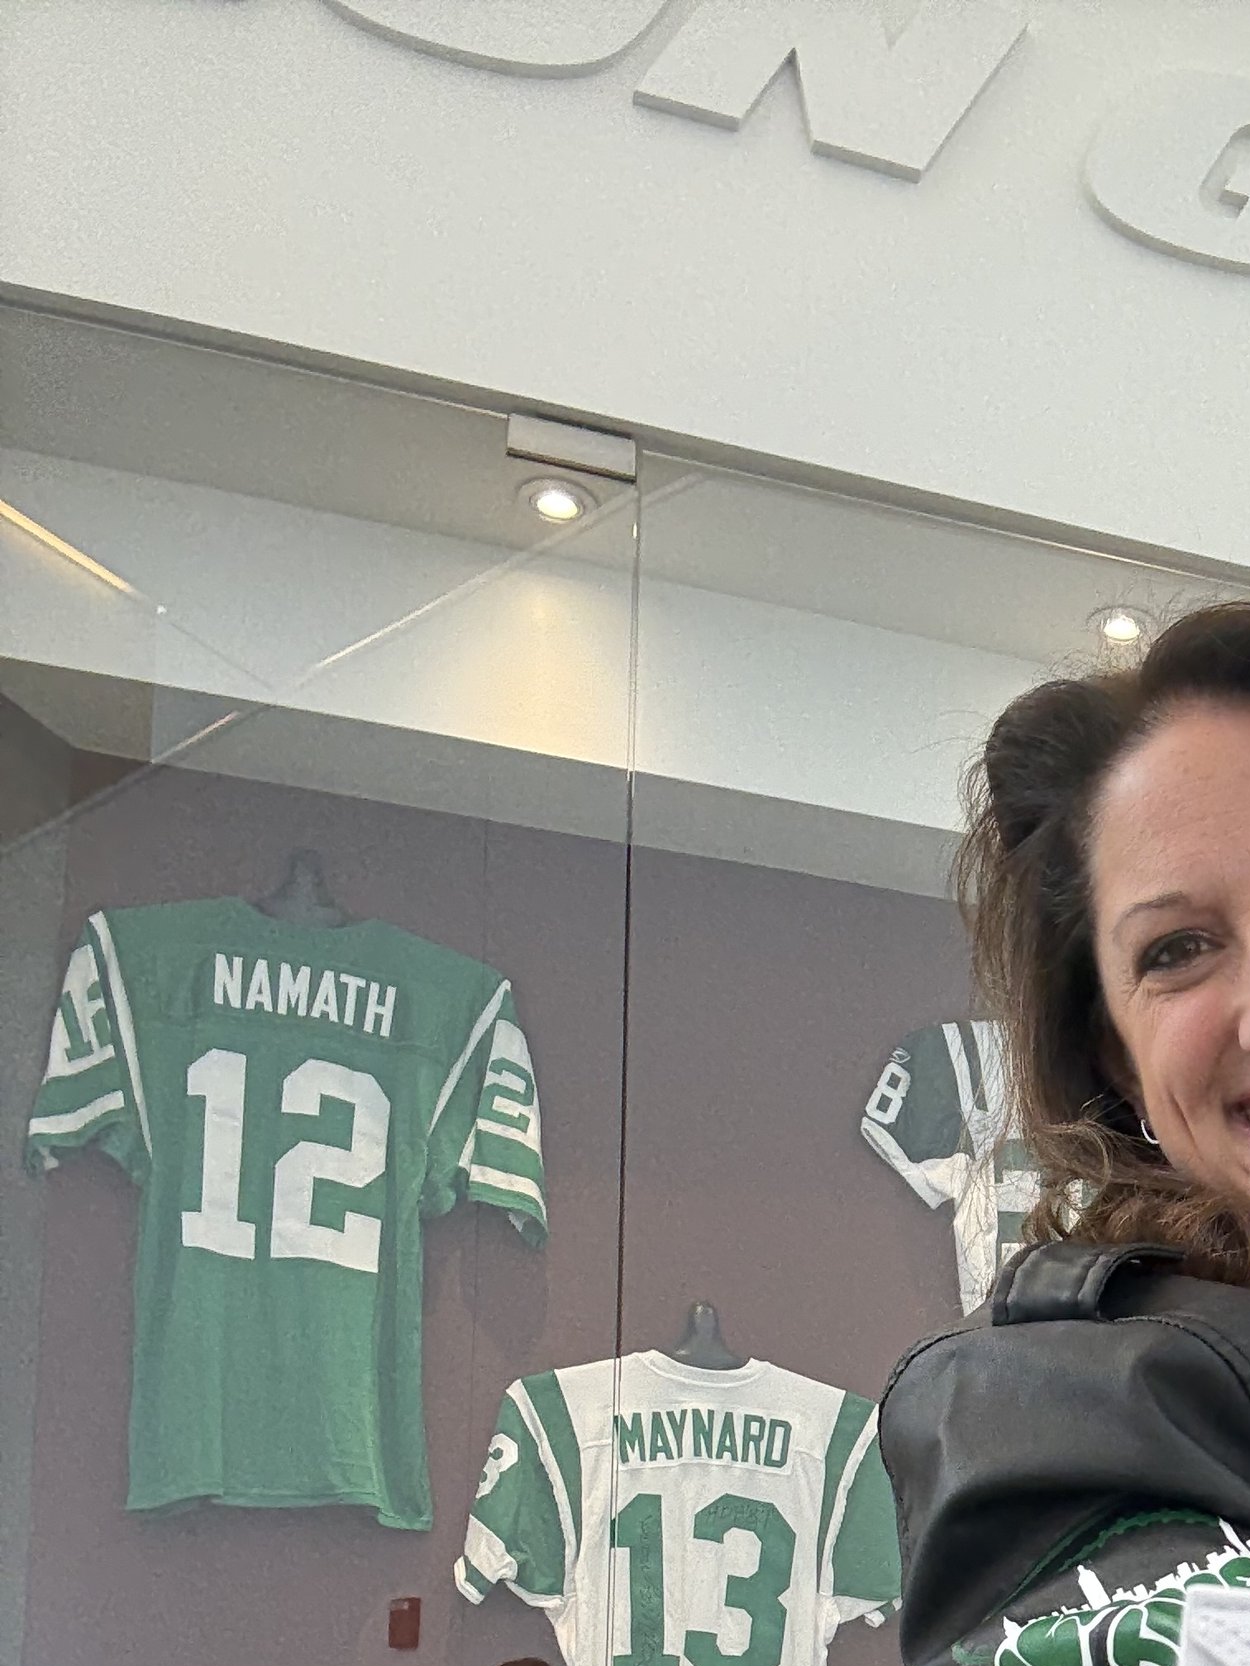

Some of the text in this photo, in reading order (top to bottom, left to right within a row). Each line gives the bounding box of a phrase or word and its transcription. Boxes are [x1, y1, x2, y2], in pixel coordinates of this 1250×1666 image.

[212, 952, 398, 1038] NAMATH
[181, 1047, 391, 1274] 12
[614, 1408, 793, 1470] MAYNARD
